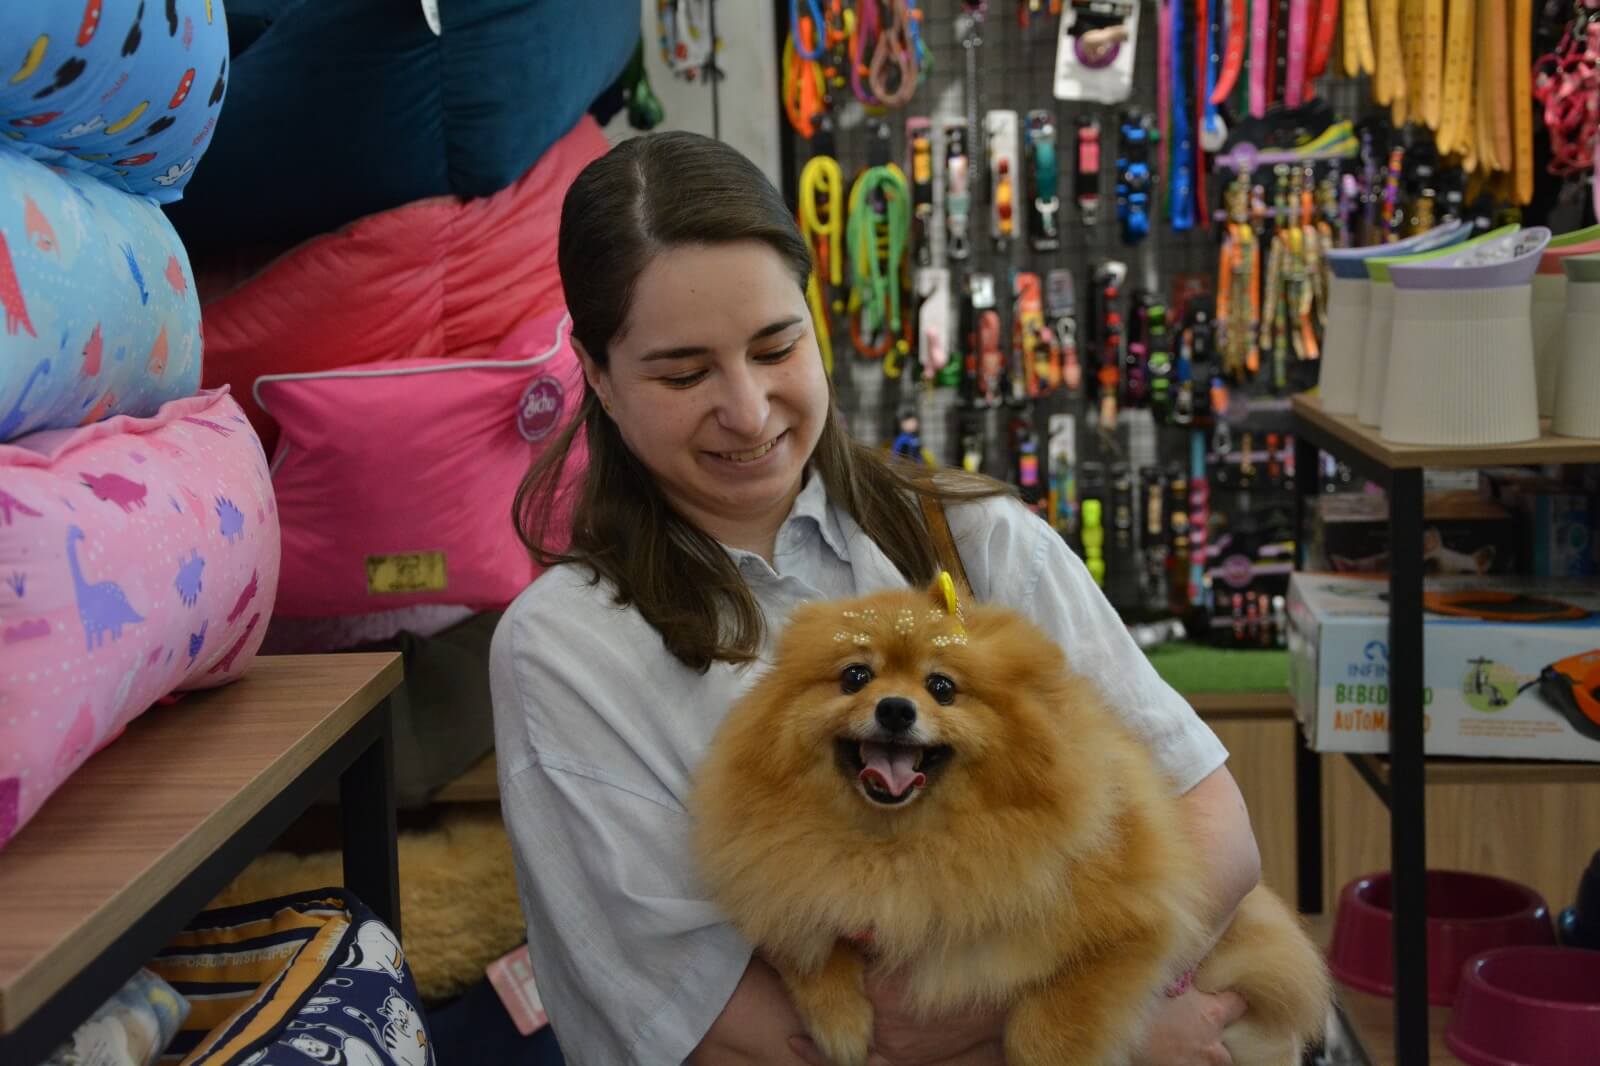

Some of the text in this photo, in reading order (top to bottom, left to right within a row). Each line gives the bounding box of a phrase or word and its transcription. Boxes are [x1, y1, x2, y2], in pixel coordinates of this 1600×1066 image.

[1347, 664, 1390, 677] INFIN
[1335, 683, 1433, 705] BEBEDO
[1333, 709, 1431, 733] AUTOMO
